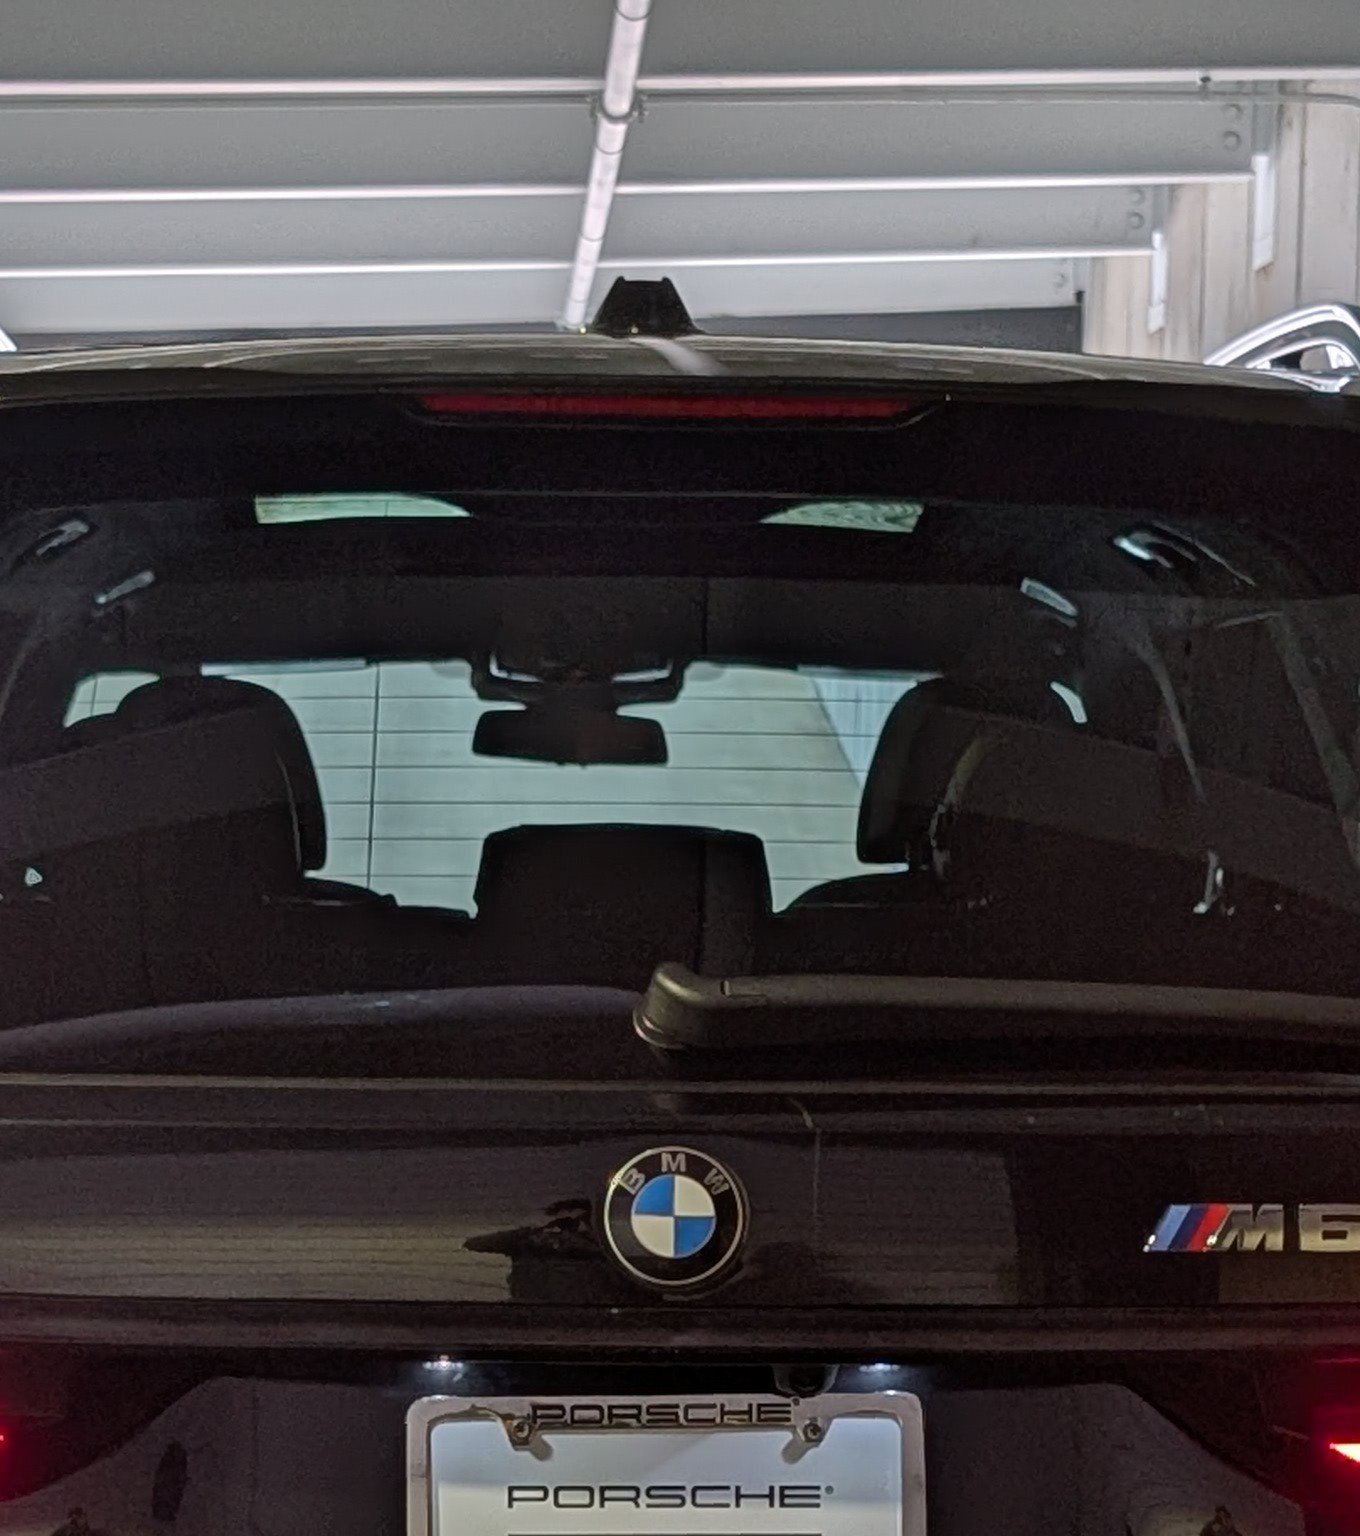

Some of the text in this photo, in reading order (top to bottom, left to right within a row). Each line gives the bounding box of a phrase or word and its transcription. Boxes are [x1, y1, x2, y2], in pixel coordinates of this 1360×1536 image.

[619, 1152, 730, 1196] BMW
[530, 1402, 792, 1426] PORSCHE
[507, 1485, 821, 1509] PORSCHE
